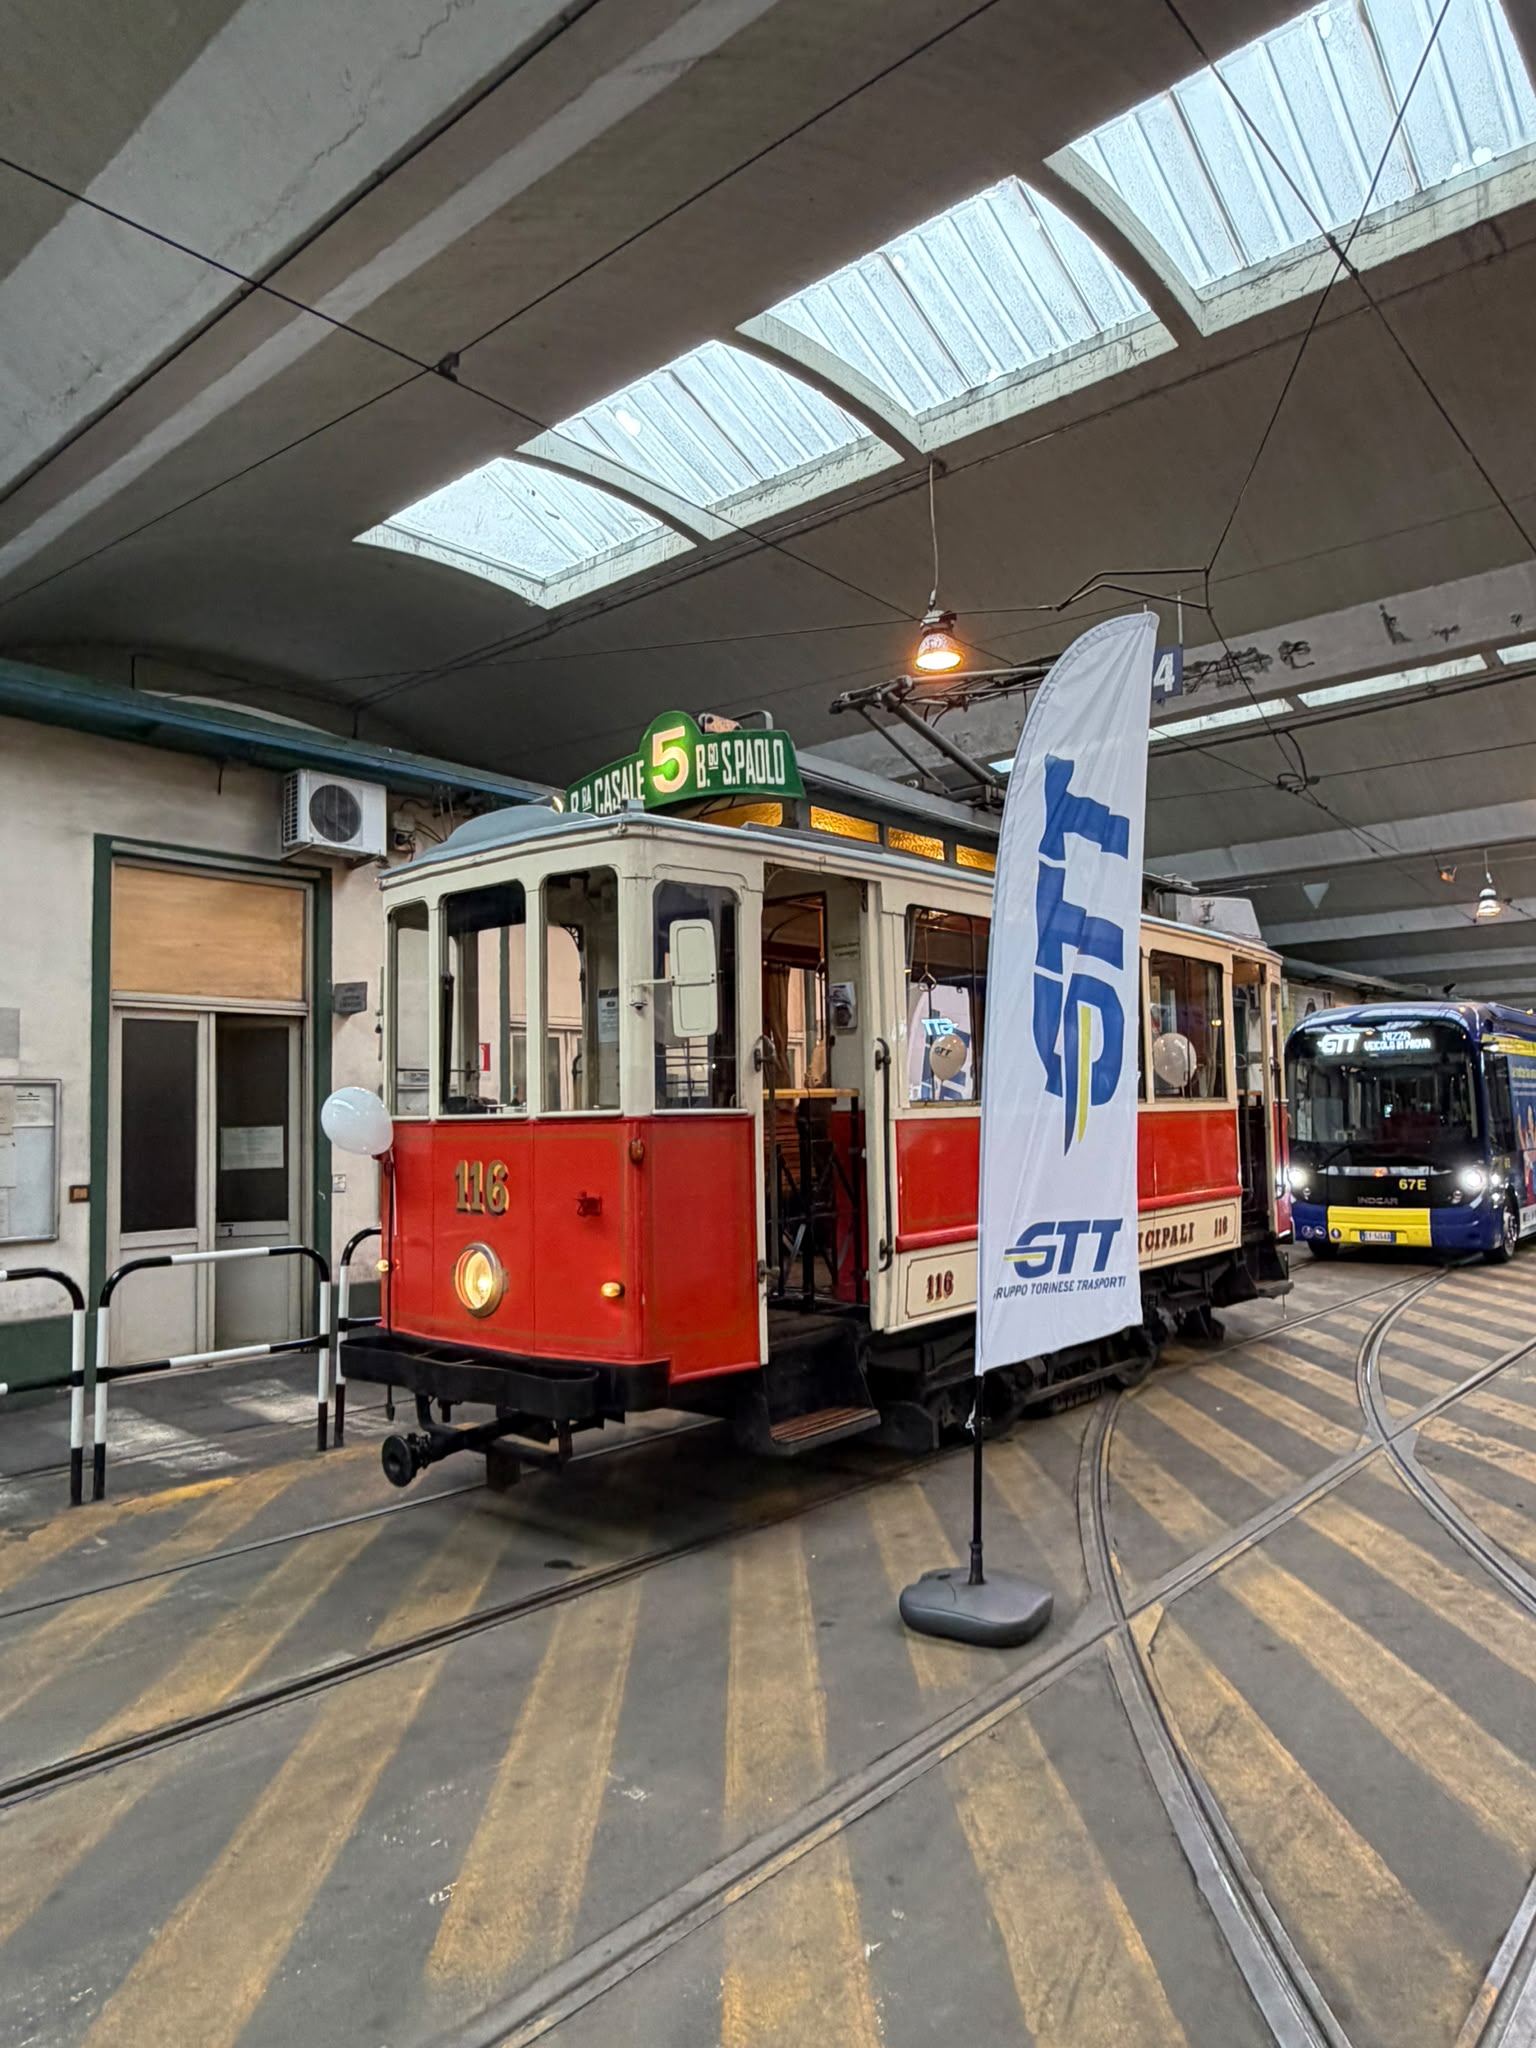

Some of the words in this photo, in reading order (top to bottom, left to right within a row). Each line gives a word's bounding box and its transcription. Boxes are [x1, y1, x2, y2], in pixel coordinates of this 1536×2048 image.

[1153, 652, 1176, 693] 4
[594, 759, 646, 814] CASALE
[651, 725, 690, 794] 5
[721, 738, 785, 785] S.PAOLO
[1033, 753, 1129, 1156] GTT
[1316, 1033, 1360, 1055] GTT
[1382, 1031, 1411, 1042] NIZZA
[454, 1159, 510, 1217] 116
[1398, 1178, 1428, 1191] 67E
[1003, 1217, 1124, 1279] GTT
[1138, 1221, 1195, 1255] ICIPALI
[1030, 1279, 1074, 1296] TORINESE
[1076, 1275, 1127, 1292] TRASPORTI
